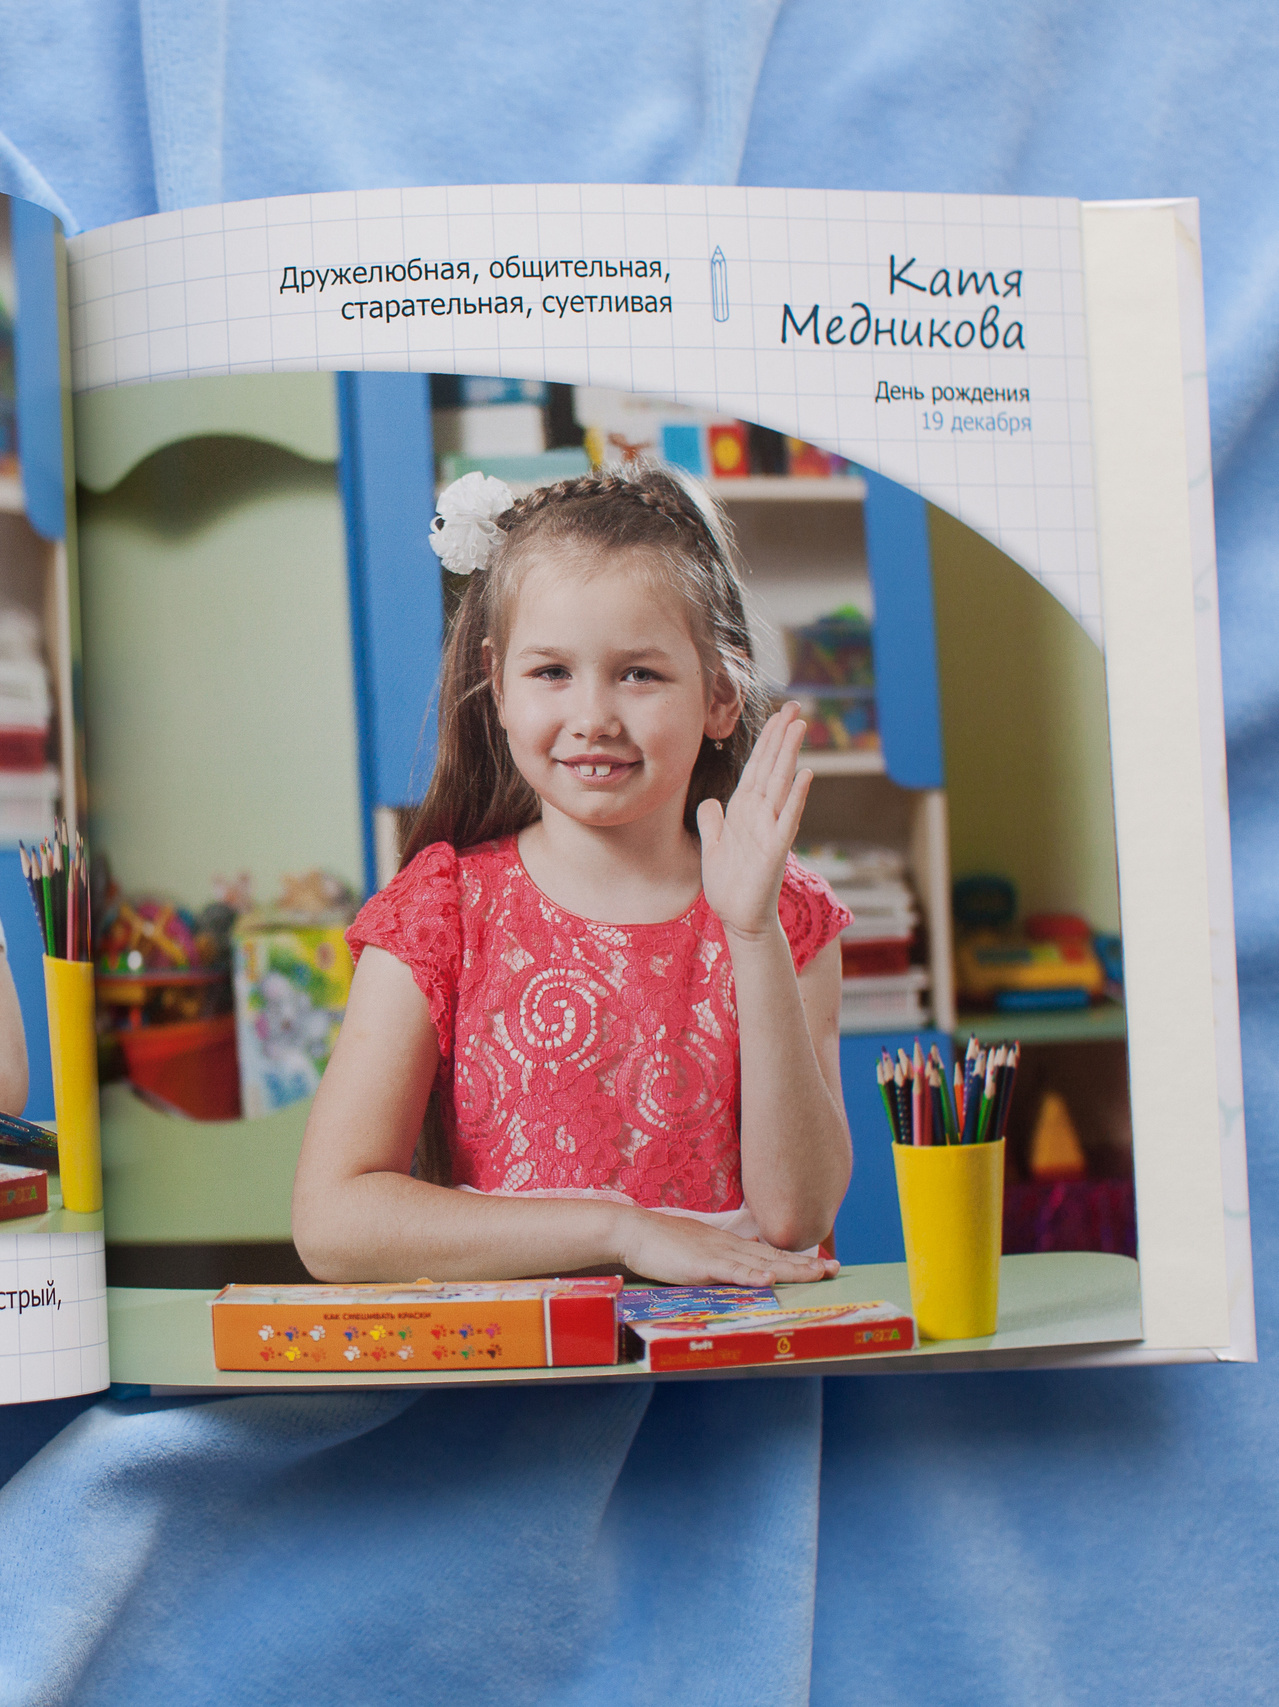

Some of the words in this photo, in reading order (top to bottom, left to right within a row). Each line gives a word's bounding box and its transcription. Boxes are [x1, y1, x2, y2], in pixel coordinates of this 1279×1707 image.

[279, 257, 479, 295] Дружелюбная,
[489, 254, 671, 285] общительная,
[889, 254, 1023, 298] Катя
[341, 295, 533, 324] старательная,
[542, 294, 673, 319] суетливая
[780, 303, 1026, 350] Медникова
[874, 380, 925, 404] День
[931, 385, 1031, 406] рождения
[923, 412, 944, 431] 19
[951, 410, 1032, 436] декабря
